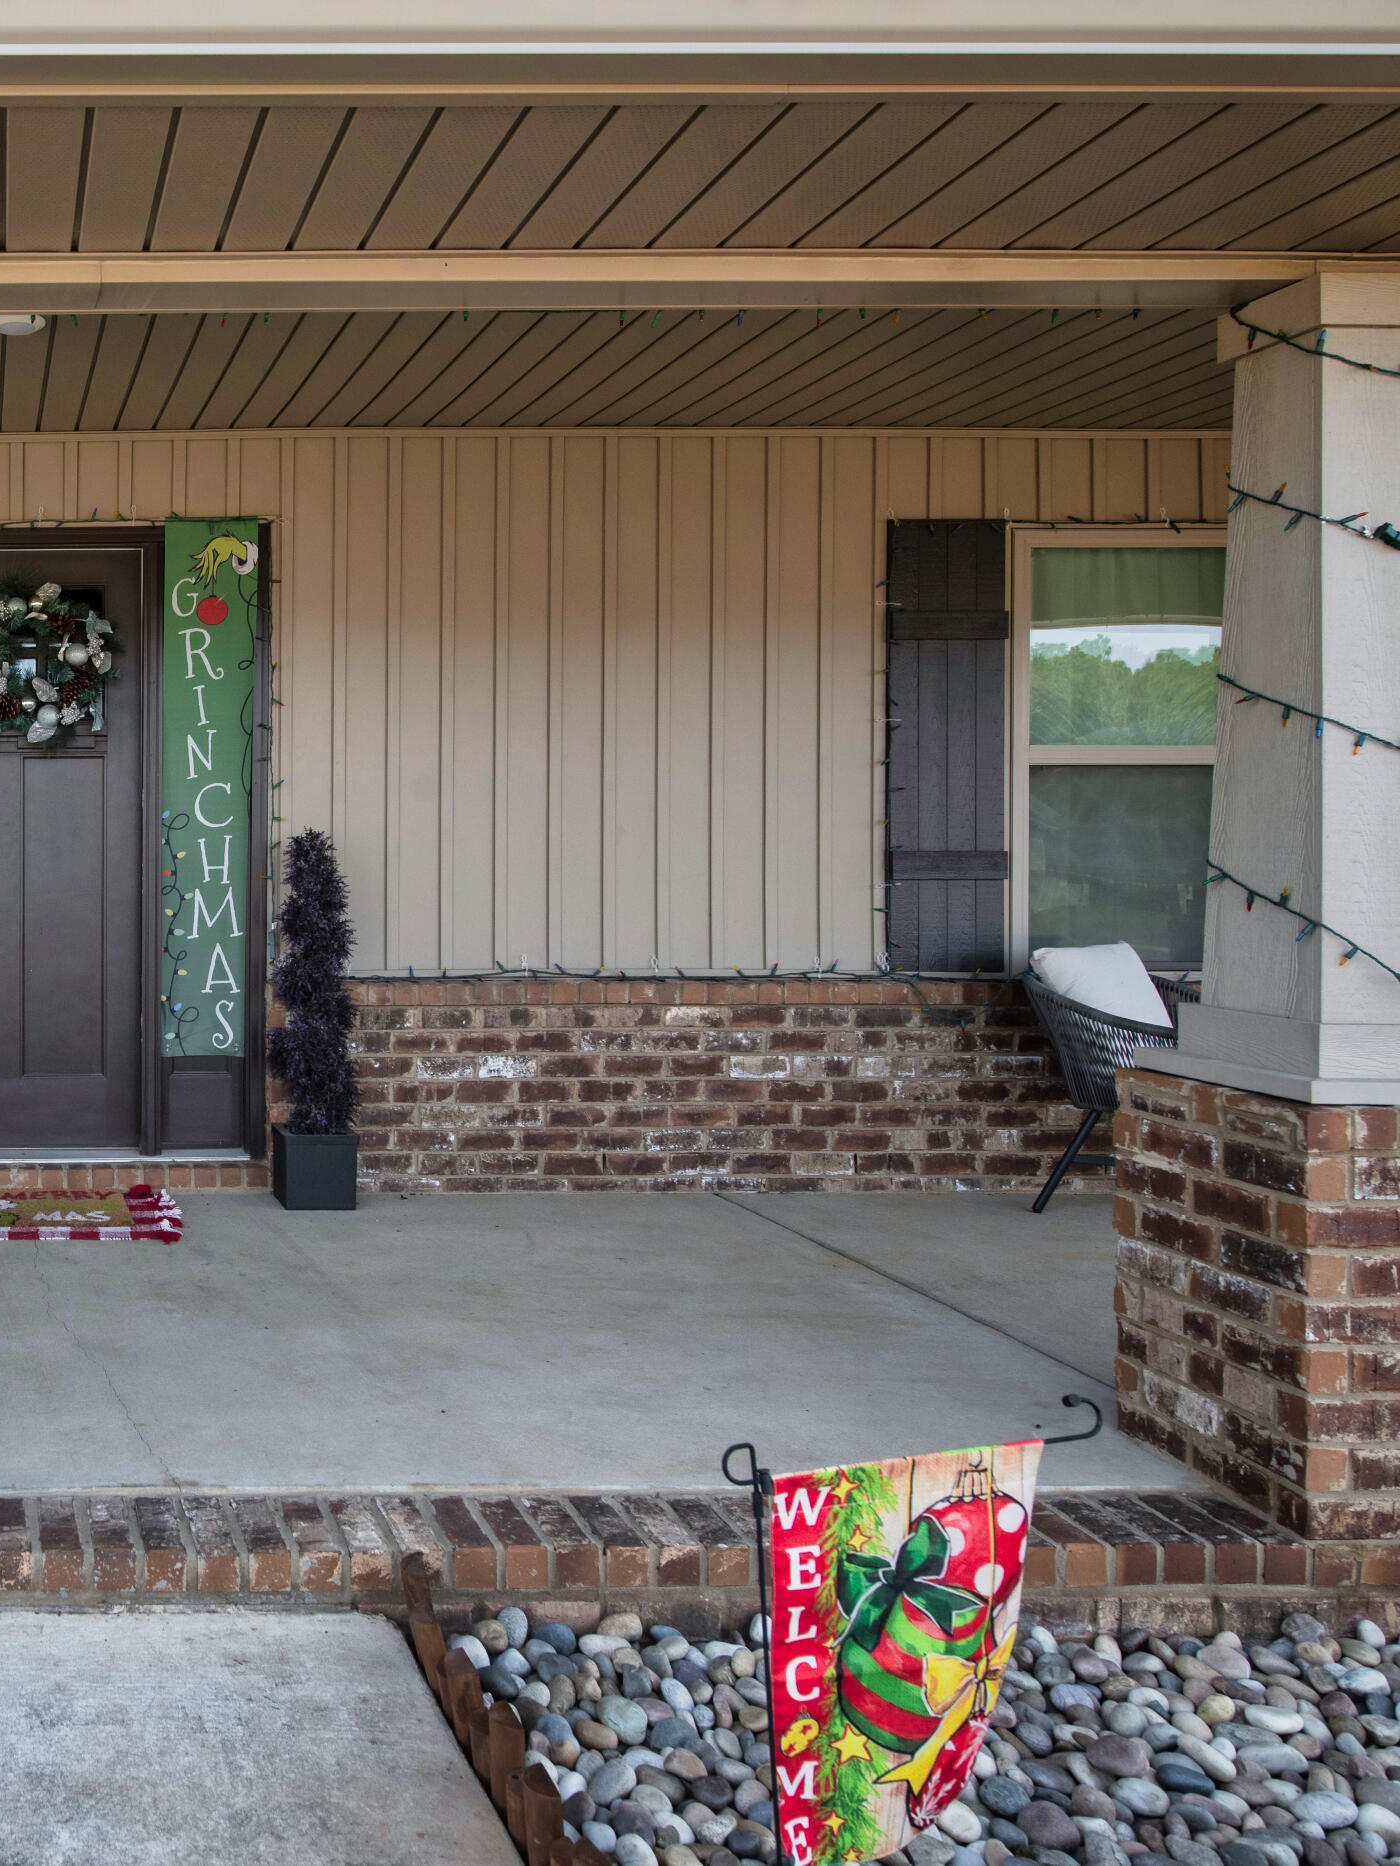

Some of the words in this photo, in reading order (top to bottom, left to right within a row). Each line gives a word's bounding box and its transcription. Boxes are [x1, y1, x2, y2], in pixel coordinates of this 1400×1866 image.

[171, 577, 244, 1050] GRINCHMAS
[1, 1190, 115, 1200] MERRY
[33, 1211, 111, 1222] MAS
